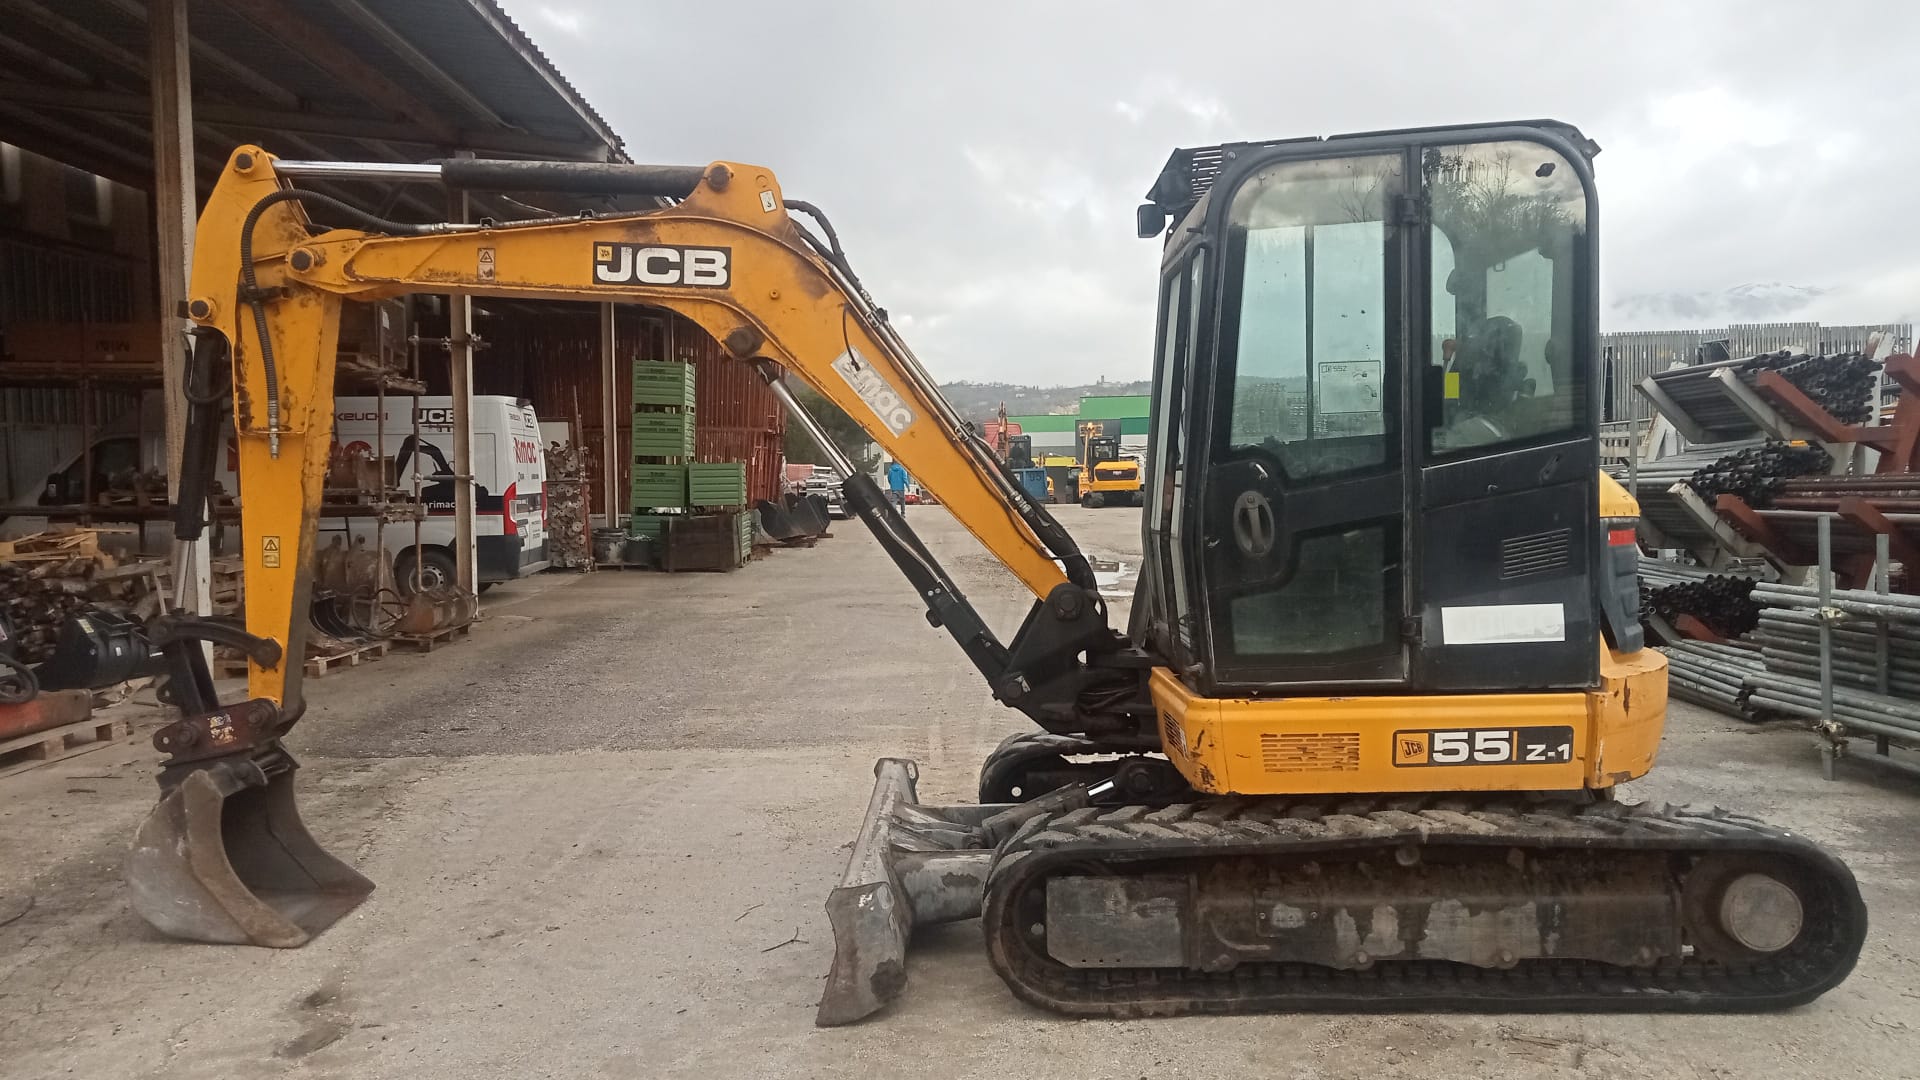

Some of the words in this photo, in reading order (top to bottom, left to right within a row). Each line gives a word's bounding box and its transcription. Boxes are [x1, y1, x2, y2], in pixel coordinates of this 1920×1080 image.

[597, 246, 728, 286] JCB
[428, 501, 456, 509] rimac
[1403, 740, 1424, 757] JCB
[1432, 730, 1511, 763] 55
[1525, 743, 1571, 761] Z-1
